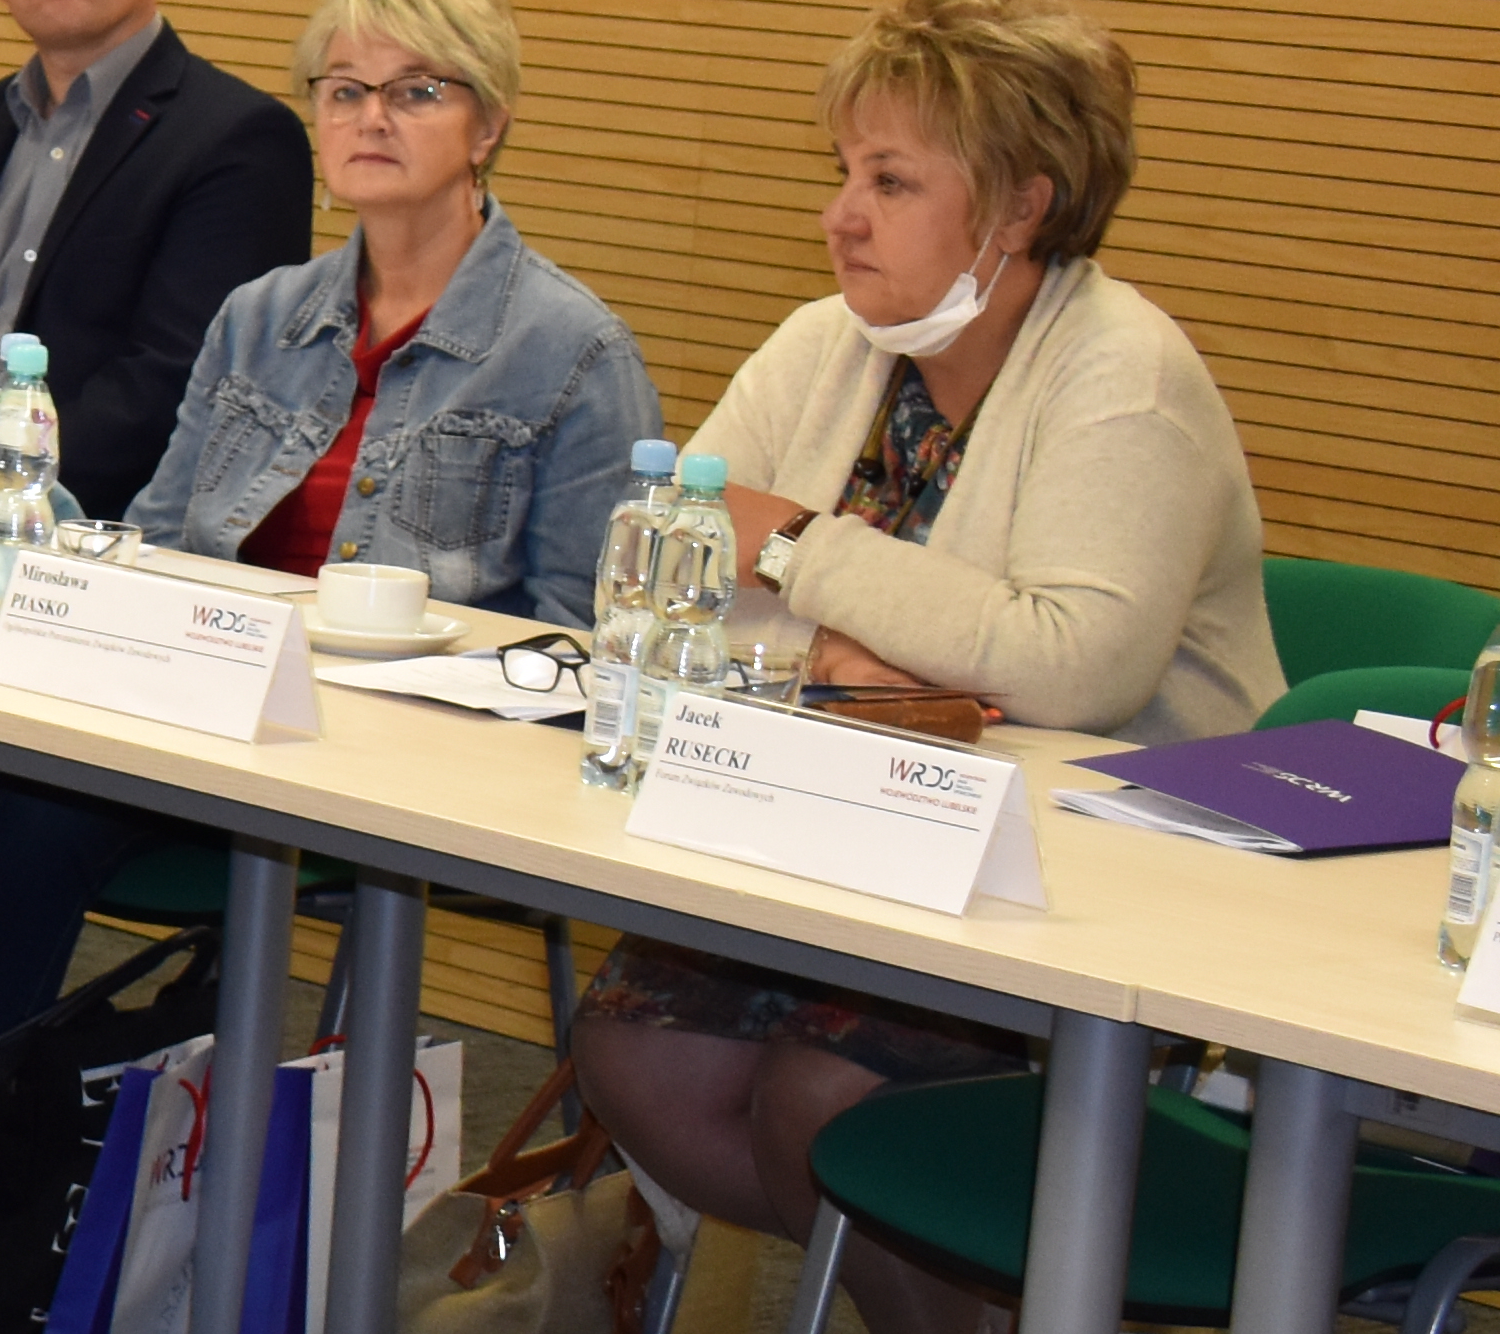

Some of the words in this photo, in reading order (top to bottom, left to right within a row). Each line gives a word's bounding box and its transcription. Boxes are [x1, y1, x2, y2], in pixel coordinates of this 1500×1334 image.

[19, 563, 89, 591] Mirosława
[10, 592, 70, 618] PIASKO
[192, 605, 246, 633] WRDS
[676, 704, 722, 729] Jacek
[665, 737, 752, 771] RUSECKI
[890, 757, 956, 791] WRDS
